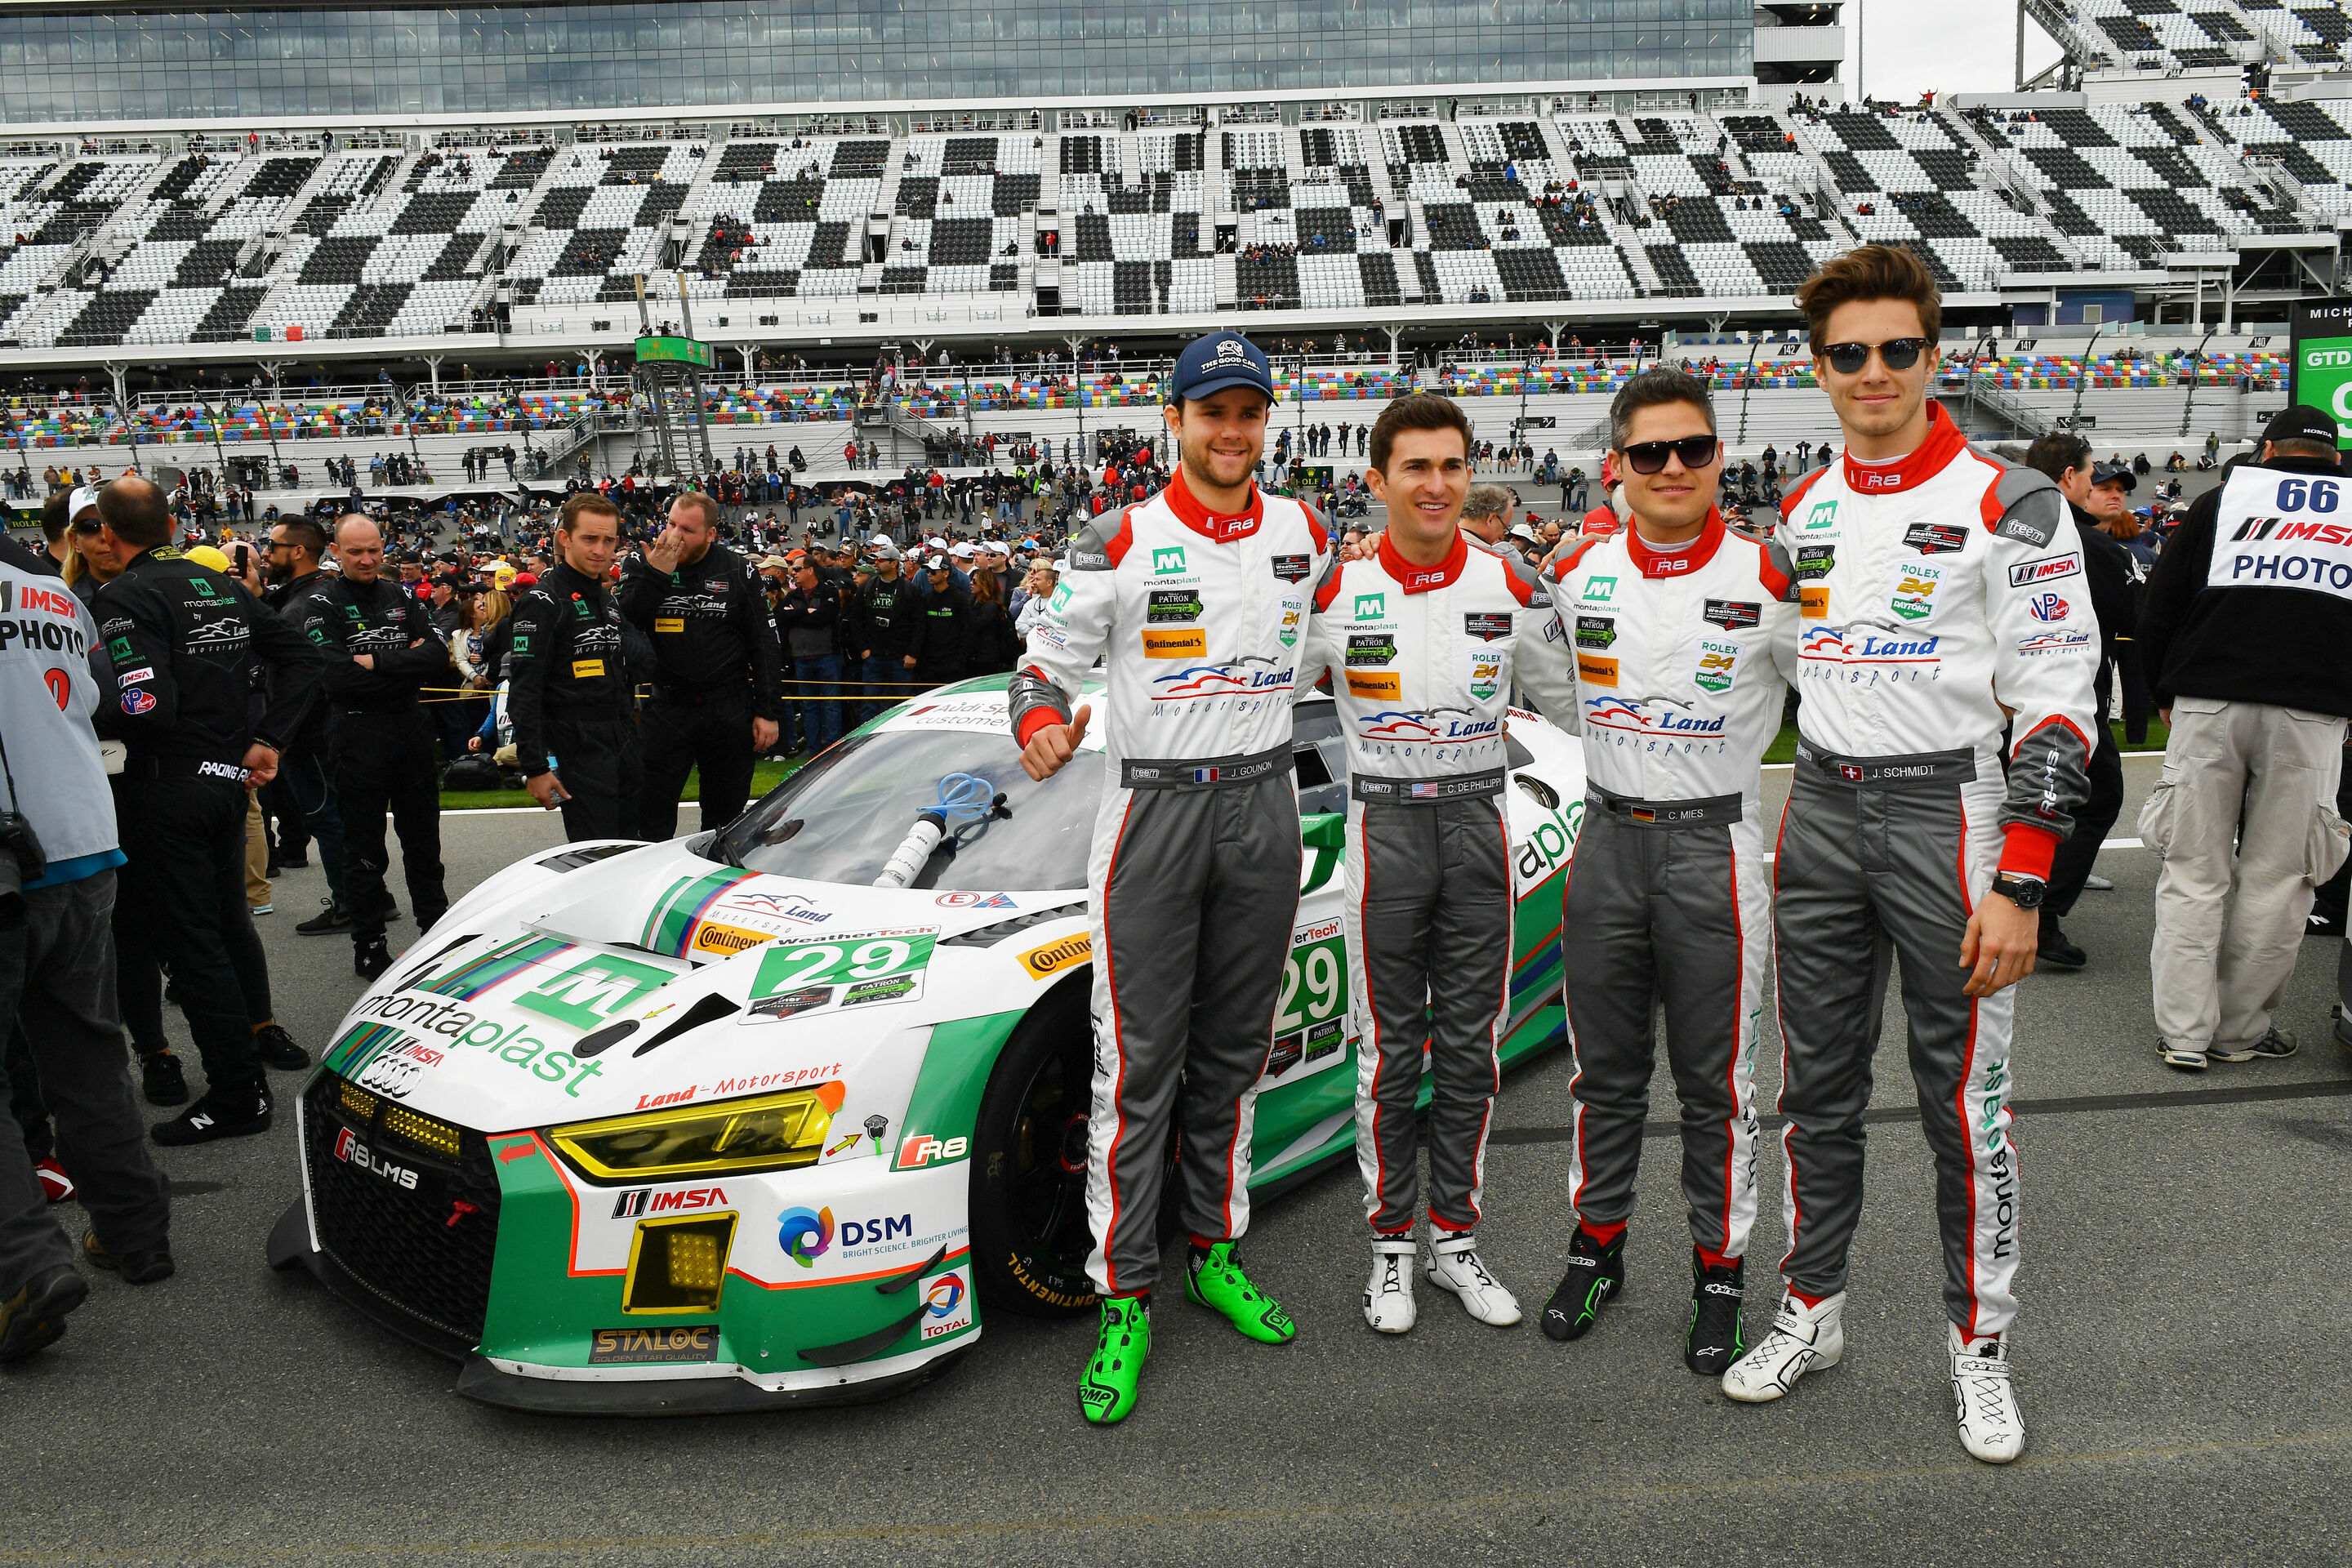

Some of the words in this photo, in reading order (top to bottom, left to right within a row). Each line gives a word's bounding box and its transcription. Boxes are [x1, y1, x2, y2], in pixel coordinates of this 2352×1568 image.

[480, 136, 488, 145] L4
[646, 131, 654, 140] L3
[2020, 340, 2032, 351] 141
[2253, 336, 2266, 348] 140
[1784, 345, 1796, 355] 142
[1200, 359, 1218, 370] THE
[2307, 350, 2351, 366] GTD
[1287, 363, 1299, 373] 144
[1019, 372, 1031, 382] 145
[744, 379, 757, 390] 146
[229, 398, 242, 408] 148
[2303, 427, 2333, 439] HONDA
[1868, 474, 1901, 488] R8
[2276, 479, 2340, 513] 66
[1227, 518, 1254, 532] R8
[2006, 519, 2046, 543] freem
[1795, 530, 1841, 541] montaplast
[1076, 551, 1105, 565] freem
[1656, 559, 1688, 572] R8
[1900, 564, 1940, 579] ROLEX
[2035, 560, 2076, 578] IMSA
[2232, 555, 2352, 589] PHOTO
[1143, 575, 1201, 587] montaplast
[1414, 572, 1445, 586] R8
[1896, 577, 1936, 597] 24
[184, 595, 238, 609] montaplast
[700, 601, 726, 610] Land
[1158, 595, 1189, 603] PATRÓN
[1281, 600, 1302, 609] ROLEX
[1573, 603, 1620, 613] montaplast
[1893, 600, 1931, 615] DAYTONA
[2030, 593, 2058, 621] VP
[193, 612, 202, 621] by
[1344, 622, 1398, 632] montaplast
[1581, 620, 1606, 630] PATRÓN
[1146, 638, 1195, 650] Continental
[1356, 638, 1384, 647] PATRÓN
[2065, 633, 2089, 644] Land
[1701, 641, 1739, 655] ROLEX
[1862, 636, 1940, 656] Land
[1472, 653, 1502, 663] ROLEX
[1698, 654, 1734, 670] 24
[1251, 667, 1294, 688] Land
[1472, 664, 1499, 679] 24
[1800, 665, 1941, 686] otorsport
[1695, 675, 1731, 687] DAYTONA
[1448, 718, 1498, 737] Land
[1659, 712, 1725, 732] Land
[198, 760, 238, 779] RACING
[1130, 766, 1160, 779] freem
[1231, 767, 1239, 777] J.
[1240, 760, 1273, 775] GOUNON
[1873, 768, 1880, 777] J.
[1882, 764, 1936, 777] SCHMIDT
[1360, 779, 1392, 795] freem
[1447, 783, 1456, 795] C.
[1458, 782, 1468, 792] DE
[1468, 777, 1502, 792] PHILLIPPI
[1668, 810, 1677, 820] C.
[1679, 808, 1704, 820] MIES
[949, 894, 969, 903] E
[785, 905, 833, 923] Land
[778, 926, 934, 946] WeatherTech
[1294, 921, 1339, 944] erTech
[770, 939, 911, 994] 29
[1273, 946, 1339, 1027] 29
[1313, 1024, 1336, 1039] PATRÓN
[352, 994, 604, 1098] montaplast
[403, 1042, 444, 1067] IMSA
[635, 1084, 695, 1111] Land
[713, 1061, 843, 1094] Motorsport
[915, 1135, 968, 1162] R8
[345, 1134, 371, 1168] R8
[372, 1156, 418, 1191] LMS
[650, 1187, 728, 1212] IMSA
[841, 1214, 912, 1248] DSM
[842, 1248, 871, 1259] BRIGHT
[872, 1242, 909, 1256] SCIENCE.
[911, 1232, 947, 1249] BRIGHTER
[1007, 1251, 1102, 1308] ONTINENTAL
[924, 1317, 969, 1338] TOTAL
[595, 1327, 710, 1352] STALOC
[593, 1354, 632, 1364] GOLDEN
[633, 1354, 656, 1363] STAR
[659, 1352, 708, 1362] QUALITY
